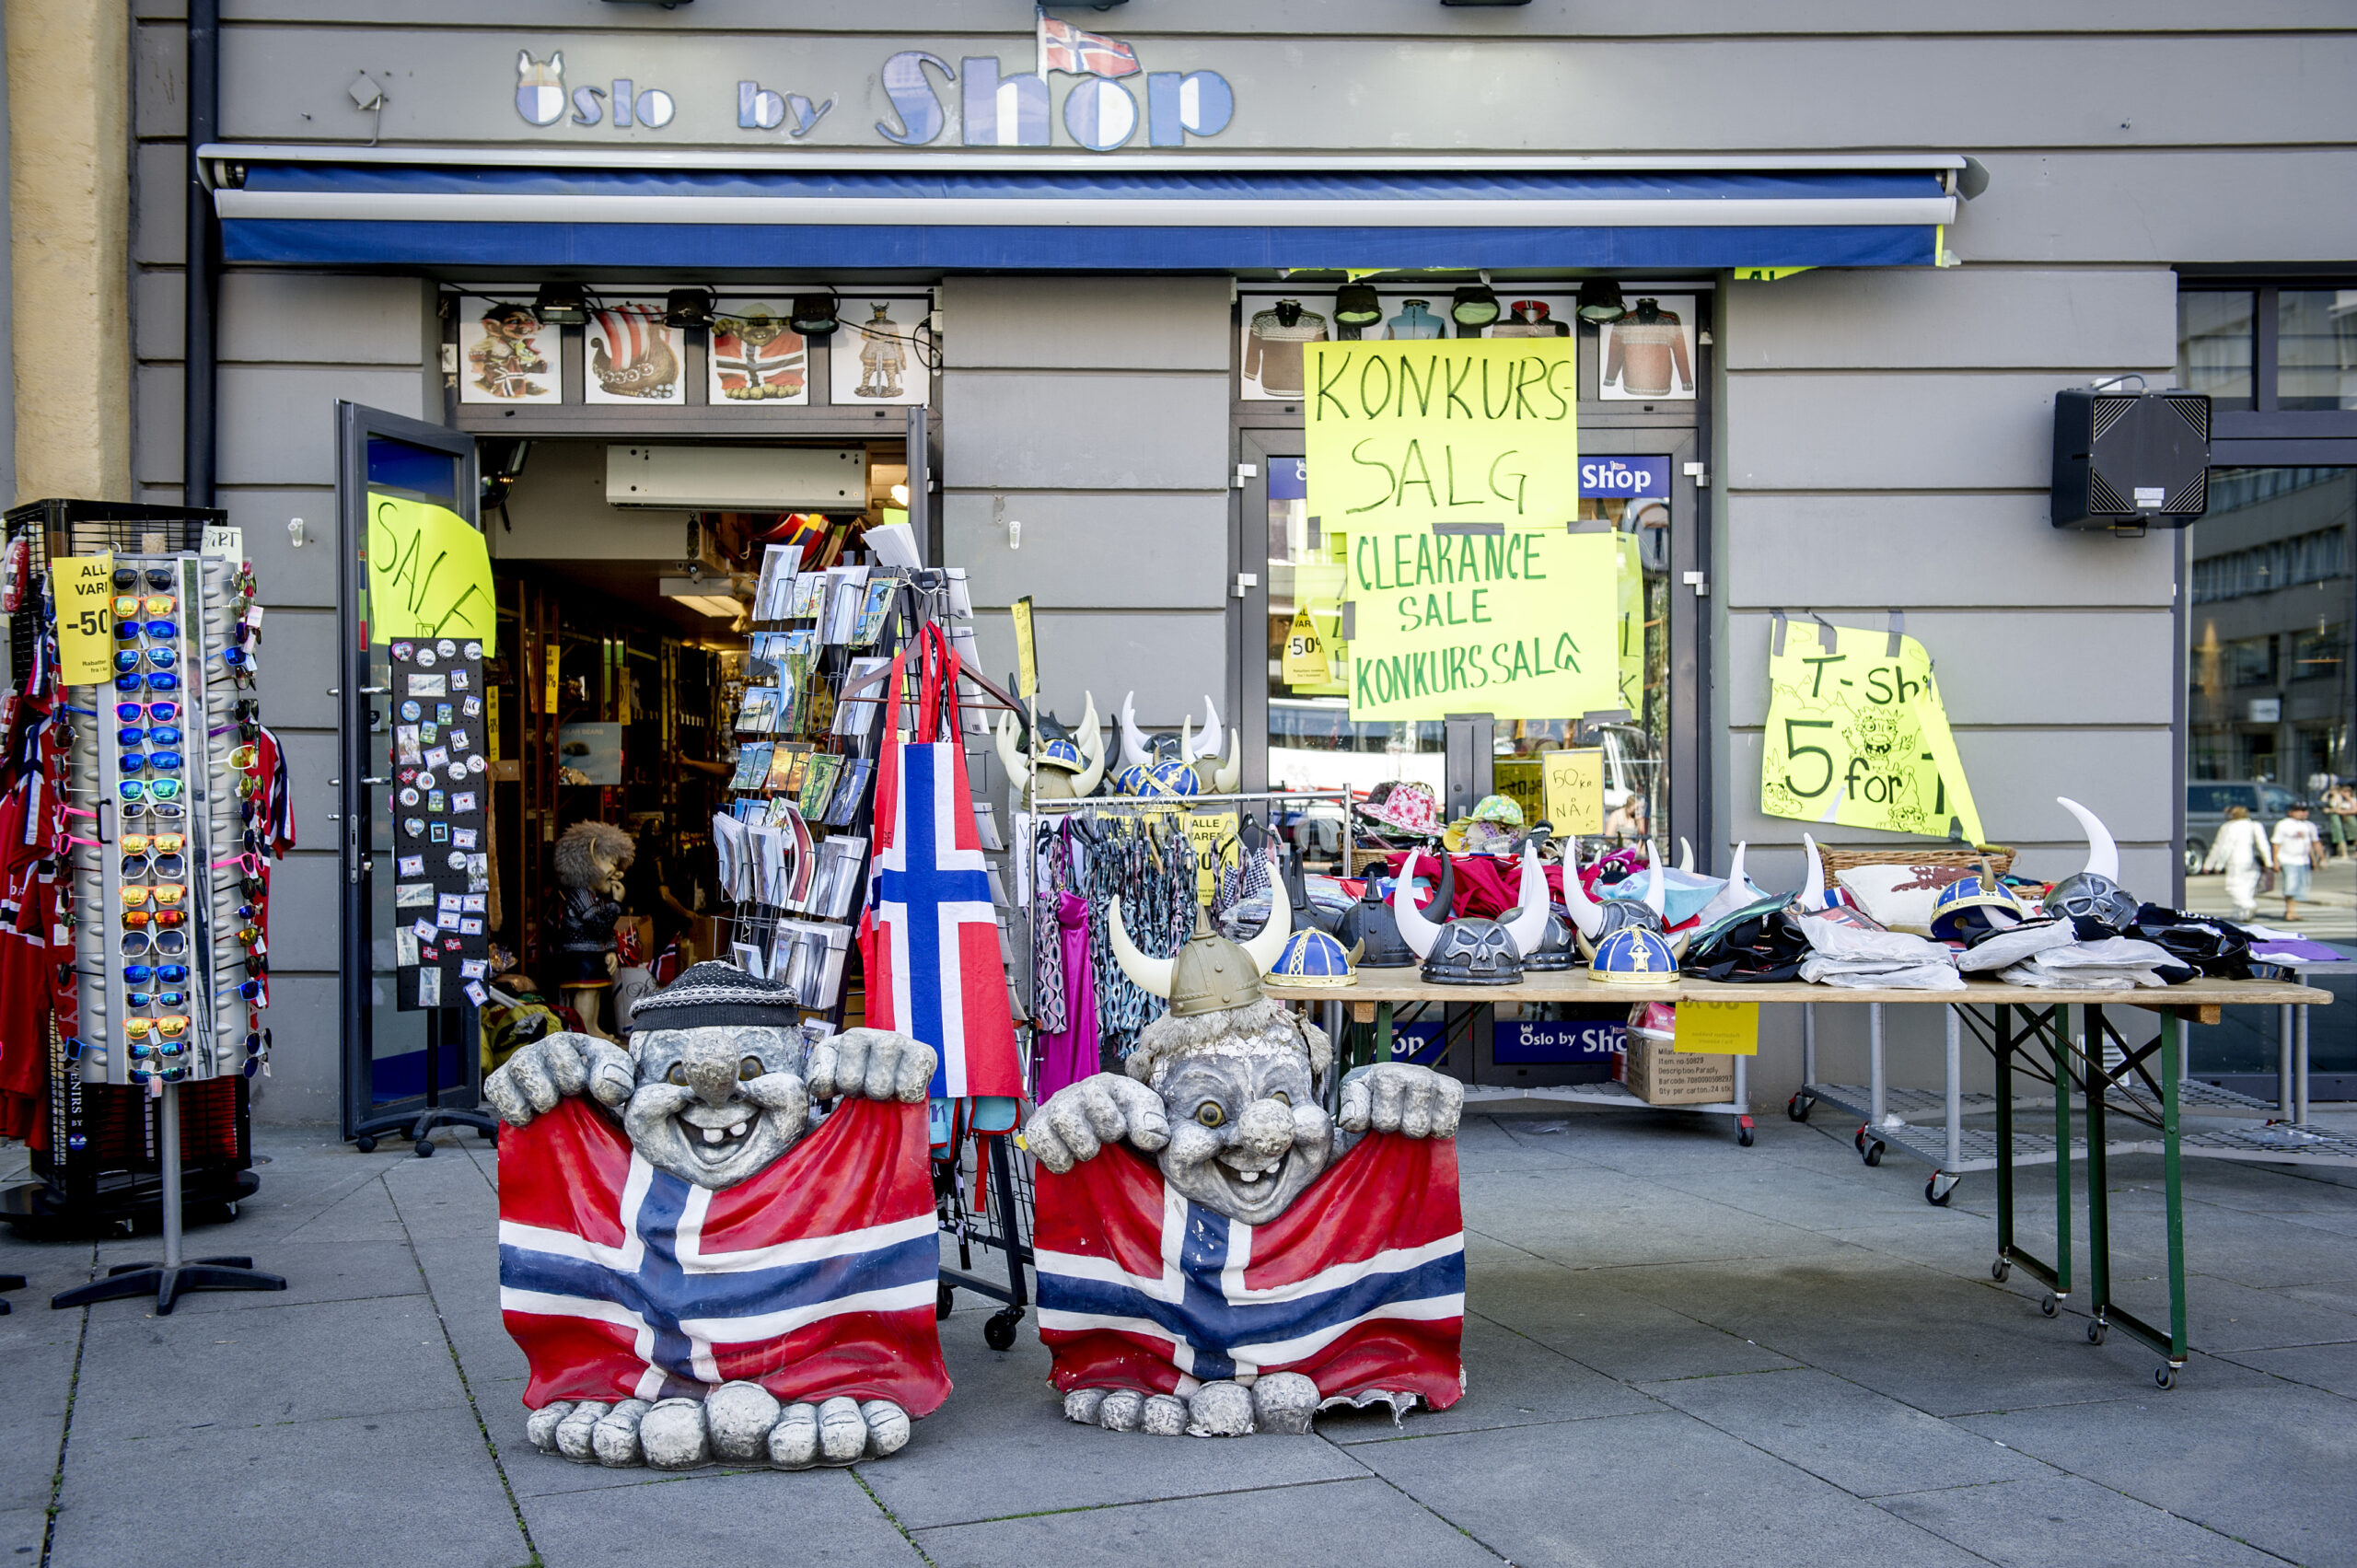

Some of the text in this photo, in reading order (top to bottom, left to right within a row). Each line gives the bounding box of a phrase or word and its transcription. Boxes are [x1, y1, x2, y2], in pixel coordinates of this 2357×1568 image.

[516, 49, 1235, 151] Oslo by Shop
[1345, 437, 1527, 516] SALG
[1583, 463, 1652, 493] Shop
[81, 564, 108, 577] ALL
[1356, 532, 1547, 591] CLEARANCE
[75, 582, 108, 596] VAR
[66, 611, 108, 636] -50
[1398, 588, 1492, 632] SALE
[1784, 718, 1834, 798] 5
[1845, 757, 1903, 805] for
[1520, 1024, 1628, 1052] Oslo by Sho
